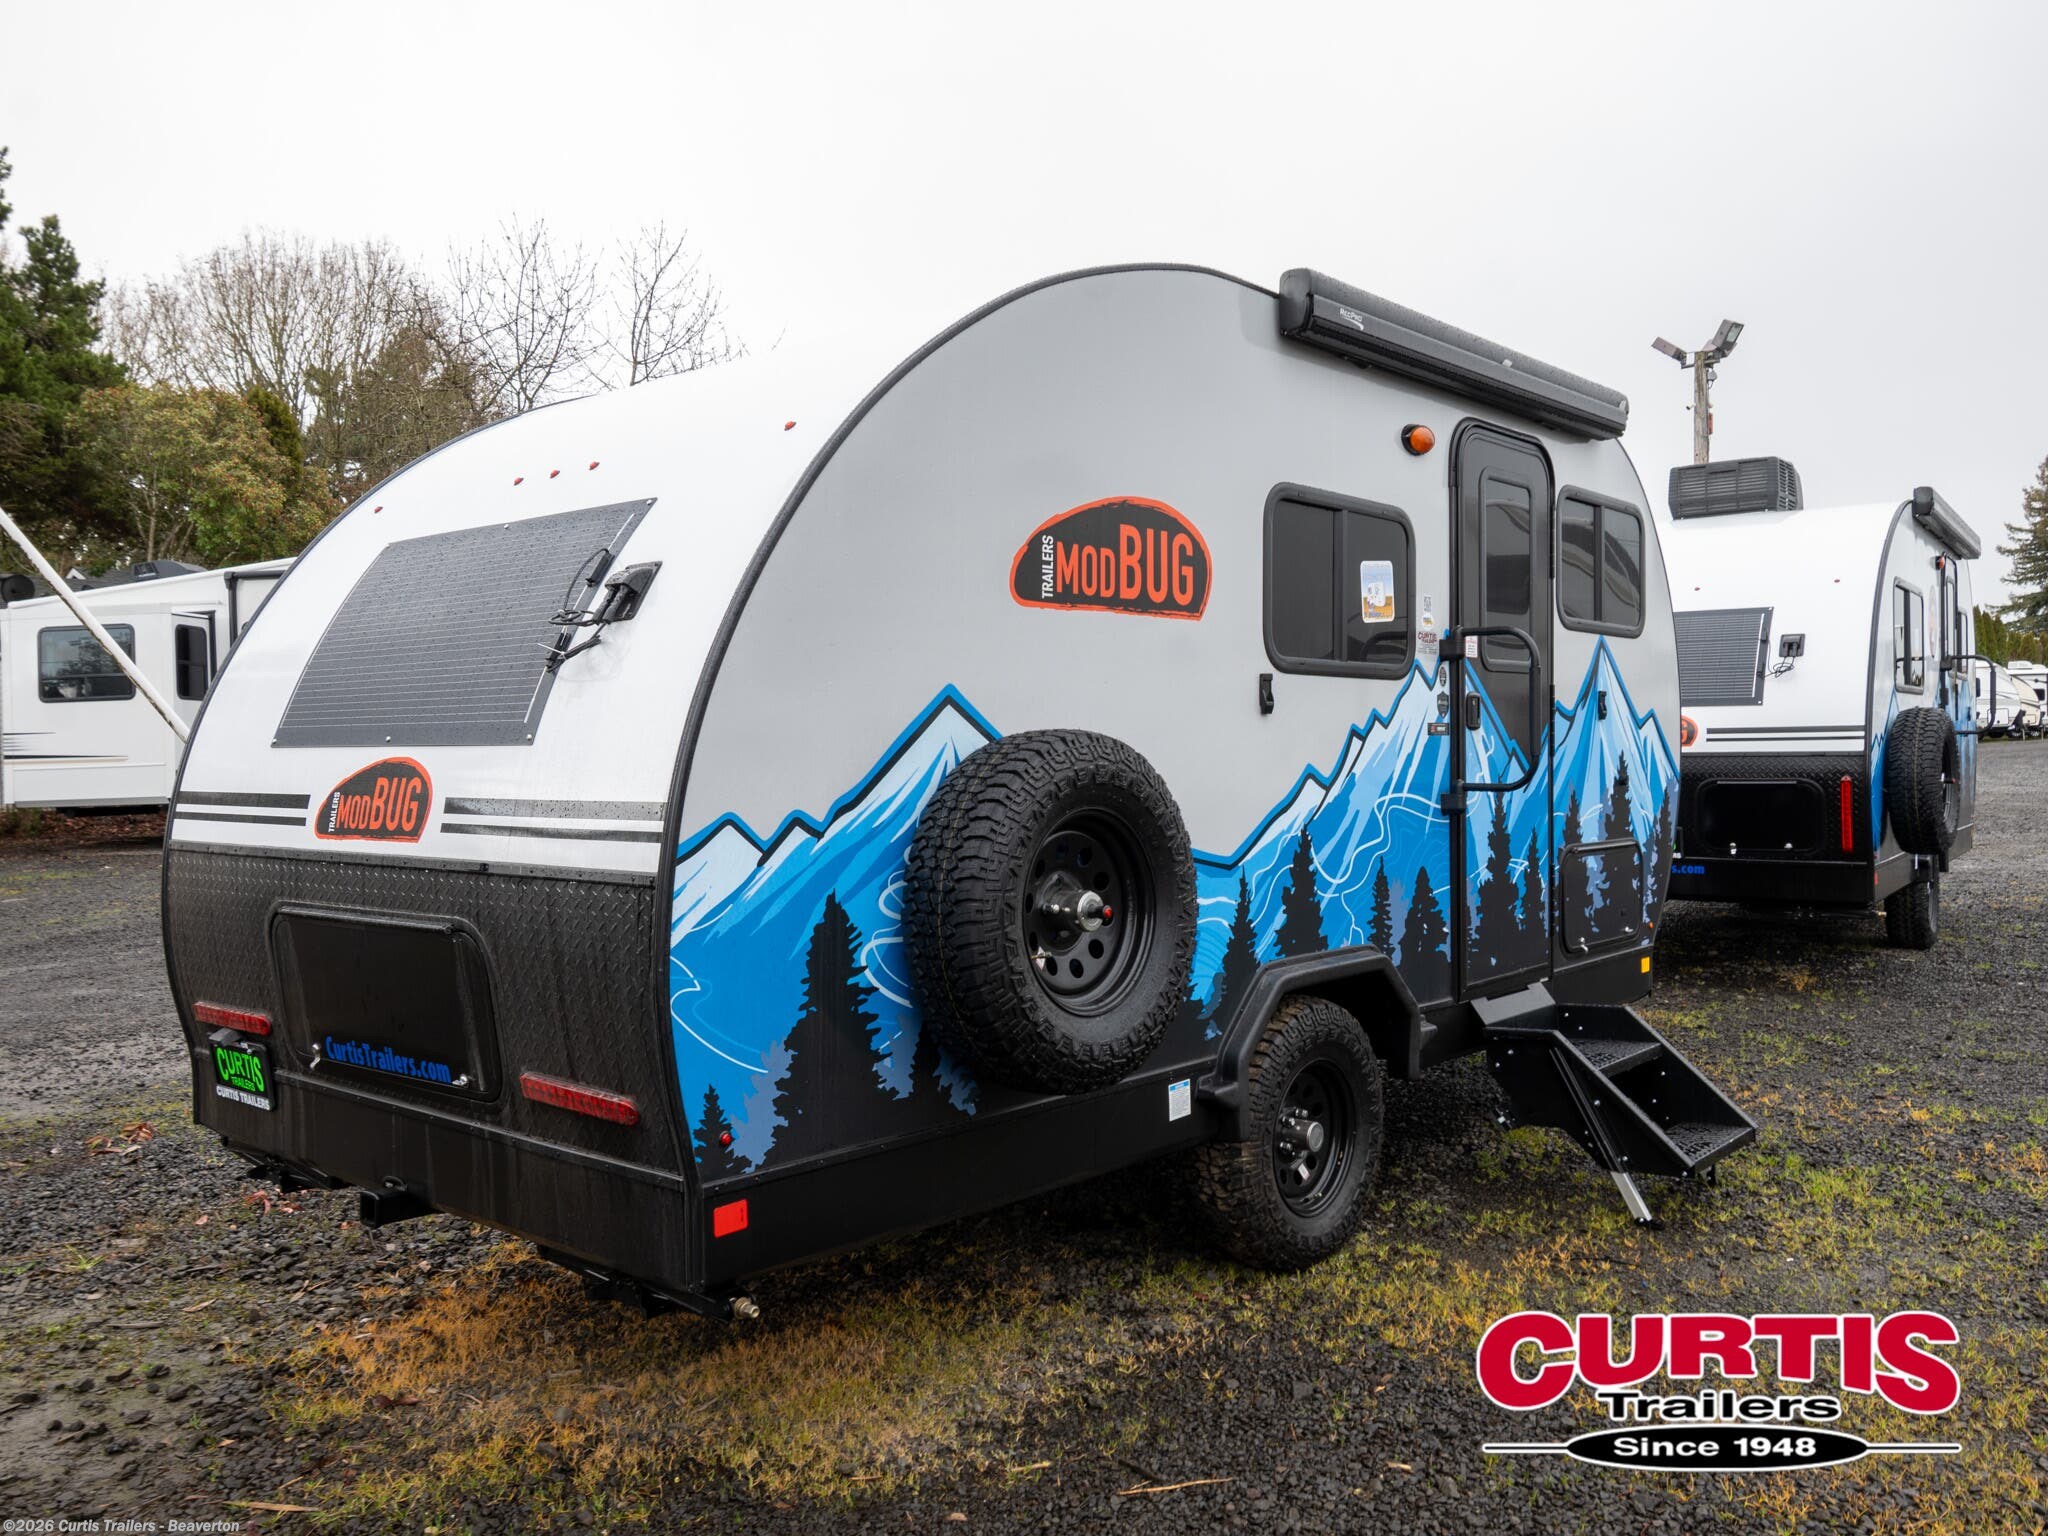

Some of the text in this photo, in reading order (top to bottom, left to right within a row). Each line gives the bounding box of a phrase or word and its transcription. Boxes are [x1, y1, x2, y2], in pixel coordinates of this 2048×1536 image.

[1042, 534, 1054, 599] TRAILERS
[328, 791, 341, 833] TRAILERS
[216, 1047, 265, 1092] CURTIS
[325, 1035, 451, 1084] CurtisTrailers.com
[216, 1085, 271, 1111] CURTIS TRAILERS
